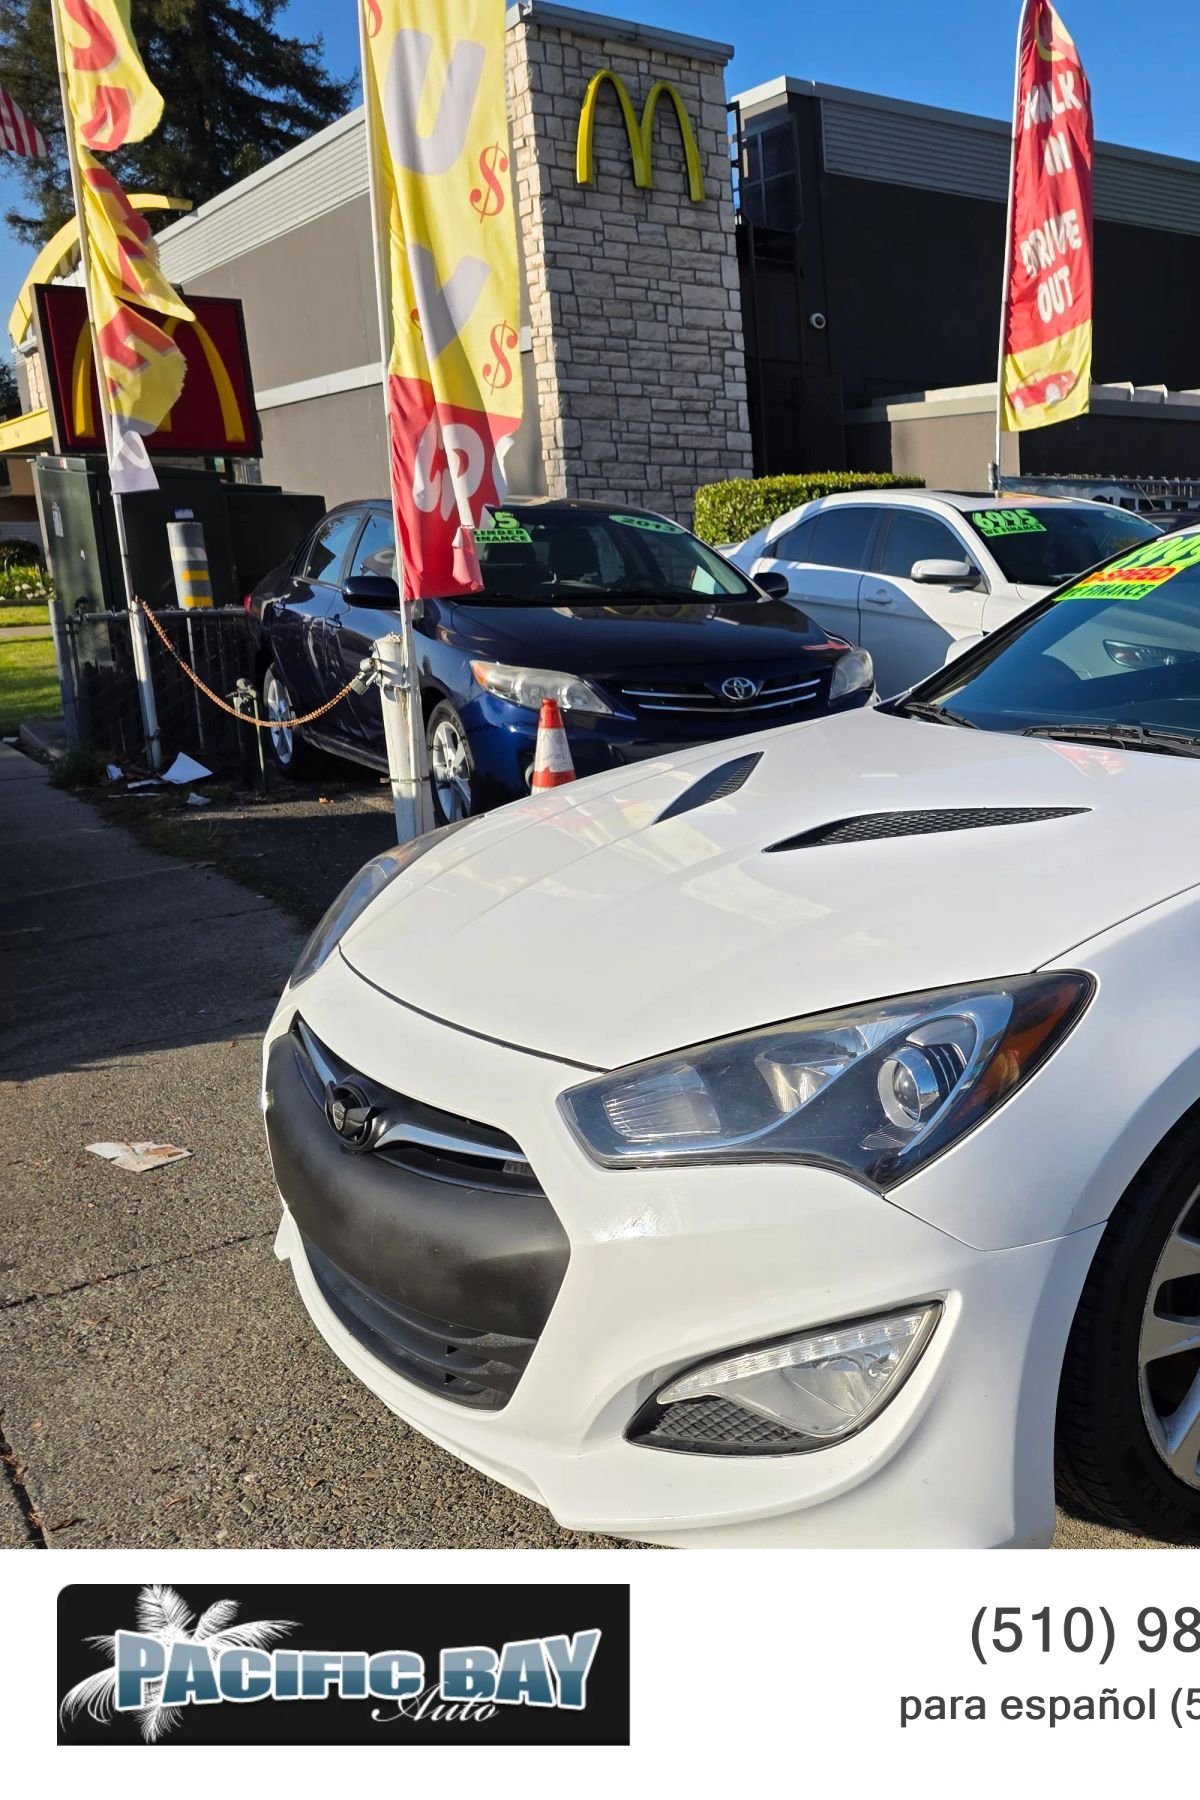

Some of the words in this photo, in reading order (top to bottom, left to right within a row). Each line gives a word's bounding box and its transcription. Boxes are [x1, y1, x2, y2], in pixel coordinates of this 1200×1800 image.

[1023, 70, 1082, 131] WALK
[577, 69, 704, 202] M
[1041, 131, 1072, 177] IN
[1020, 208, 1082, 279] DRIVE
[1037, 265, 1073, 324] OUT
[972, 509, 1039, 530] 6995
[1080, 583, 1156, 598] FINANCE
